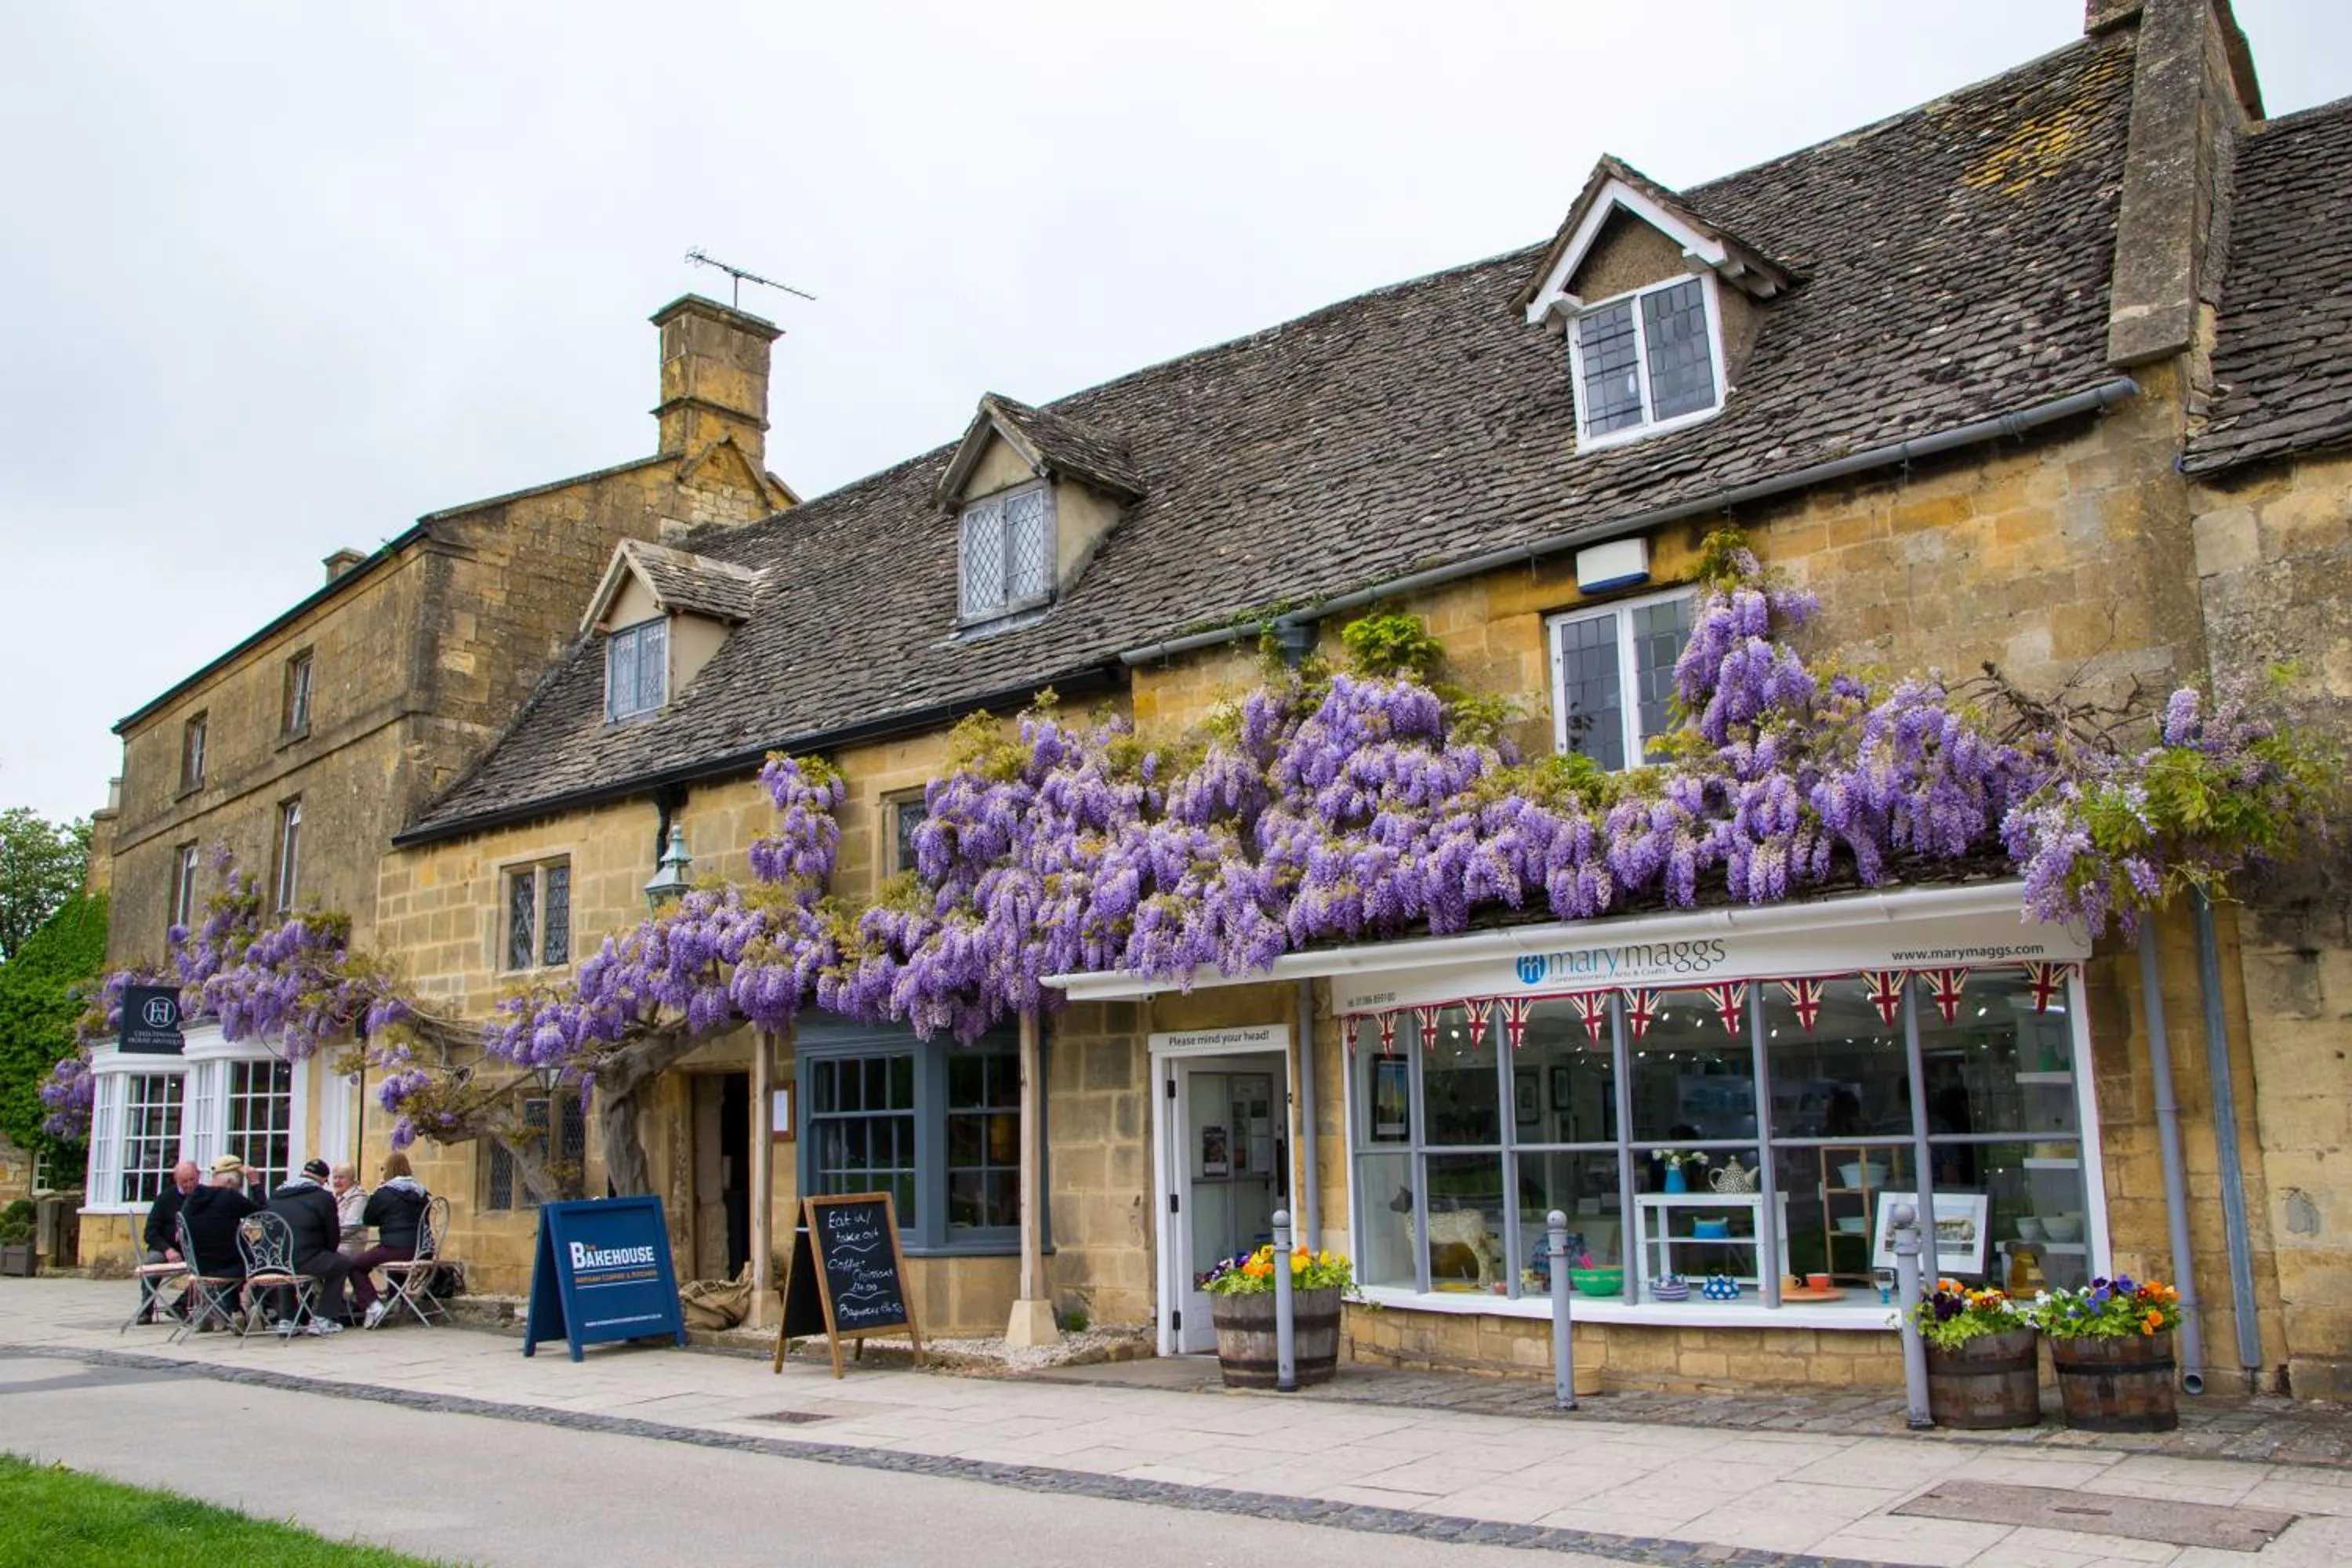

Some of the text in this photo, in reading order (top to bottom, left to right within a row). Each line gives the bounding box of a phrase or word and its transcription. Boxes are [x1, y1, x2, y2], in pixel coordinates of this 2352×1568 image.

[1892, 945, 2044, 960] www.marymaggs.com
[1169, 1030, 1269, 1047] Please mind your head!
[828, 1210, 851, 1229] Eat
[862, 1226, 879, 1240] out
[569, 1241, 655, 1269] BAKEHOUSE
